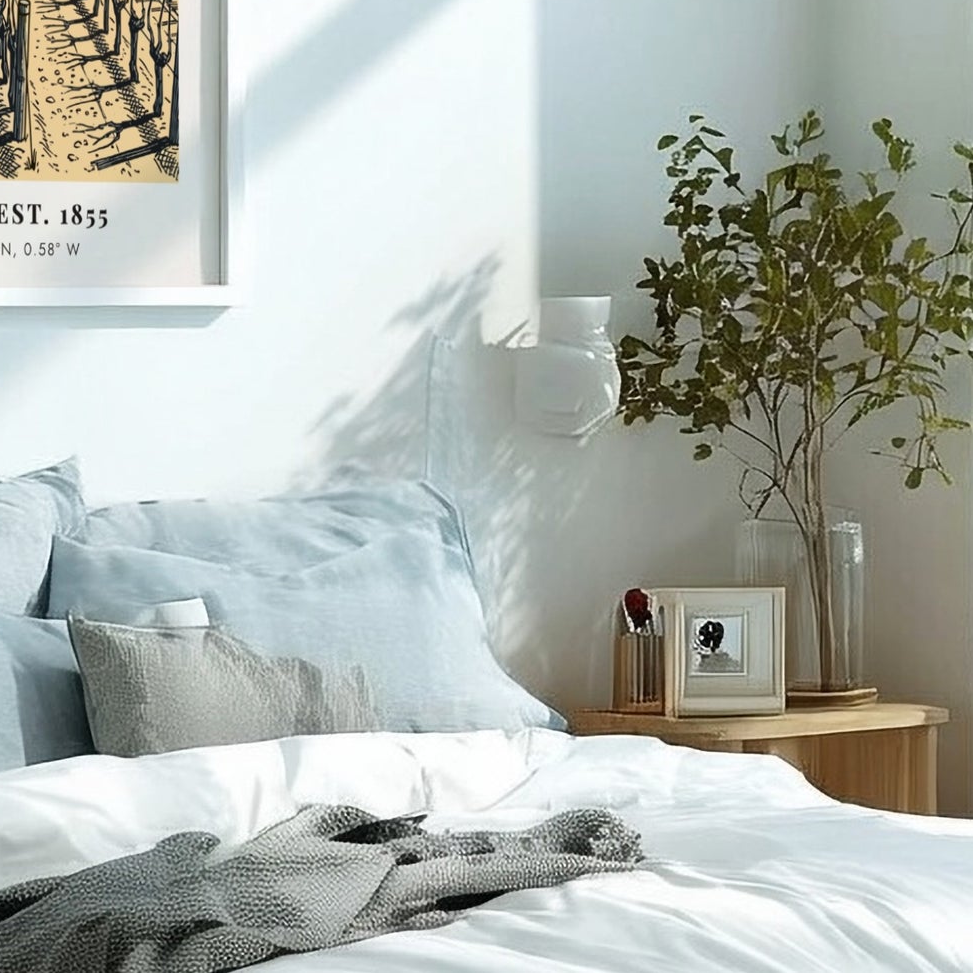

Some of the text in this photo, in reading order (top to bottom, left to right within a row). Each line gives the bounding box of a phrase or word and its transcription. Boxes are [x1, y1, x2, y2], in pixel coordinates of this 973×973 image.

[60, 203, 109, 230] 1855
[0, 242, 17, 259] N,
[66, 242, 81, 257] W
